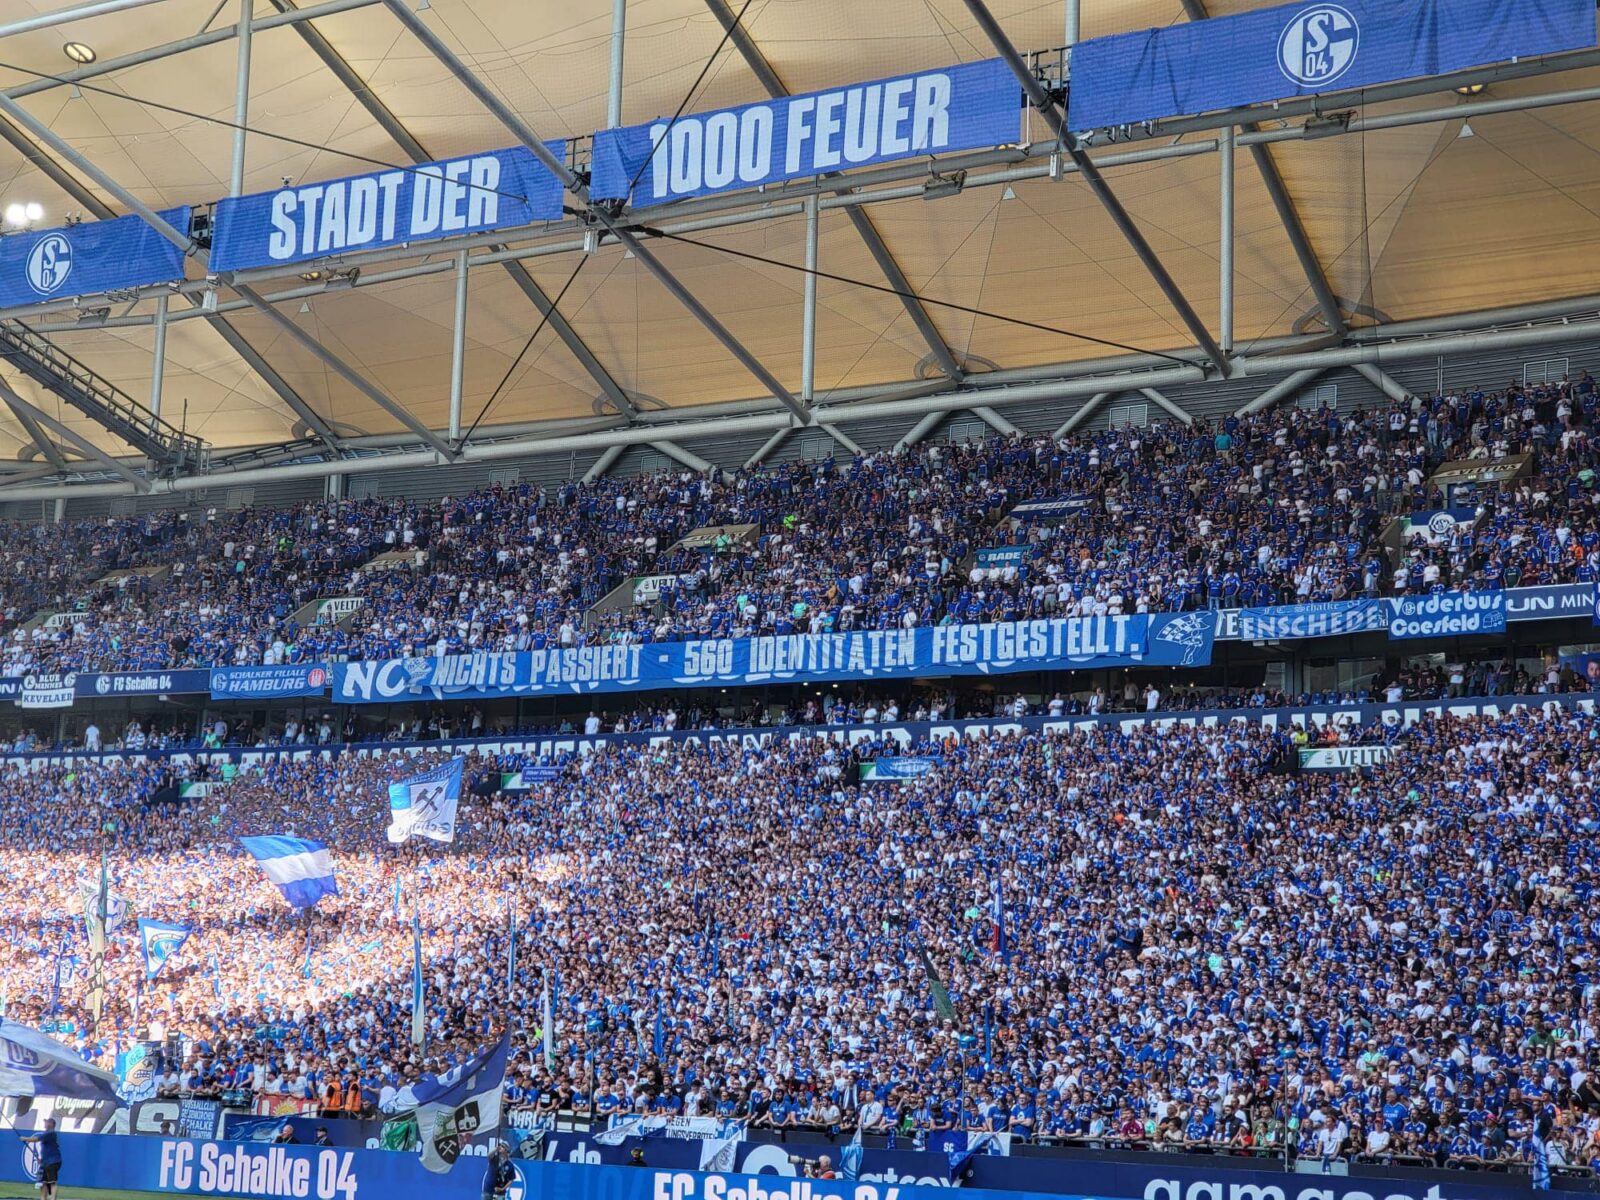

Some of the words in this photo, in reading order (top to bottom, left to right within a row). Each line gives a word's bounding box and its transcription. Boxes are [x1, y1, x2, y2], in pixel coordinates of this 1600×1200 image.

[649, 104, 774, 199] 1000
[785, 73, 951, 175] FEUER
[268, 170, 404, 260] STADT
[409, 156, 500, 236] DER
[1242, 607, 1379, 640] ENSCHEDE
[1390, 612, 1480, 636] Coesfeld
[430, 649, 517, 687] NICHTS
[530, 643, 645, 687] PASSIERT
[683, 638, 734, 676] 560
[932, 614, 1140, 665] FESTGESTELLT.
[113, 677, 126, 691] FC
[125, 677, 158, 691] Schalke
[159, 675, 172, 689] 04
[228, 677, 305, 692] HAMBURG
[229, 670, 273, 679] SCHALKER
[273, 669, 307, 677] FILIALE
[23, 693, 73, 703] KEVELAER
[159, 1140, 195, 1190] FC
[199, 1142, 309, 1197] Schalke
[317, 1150, 358, 1200] 04
